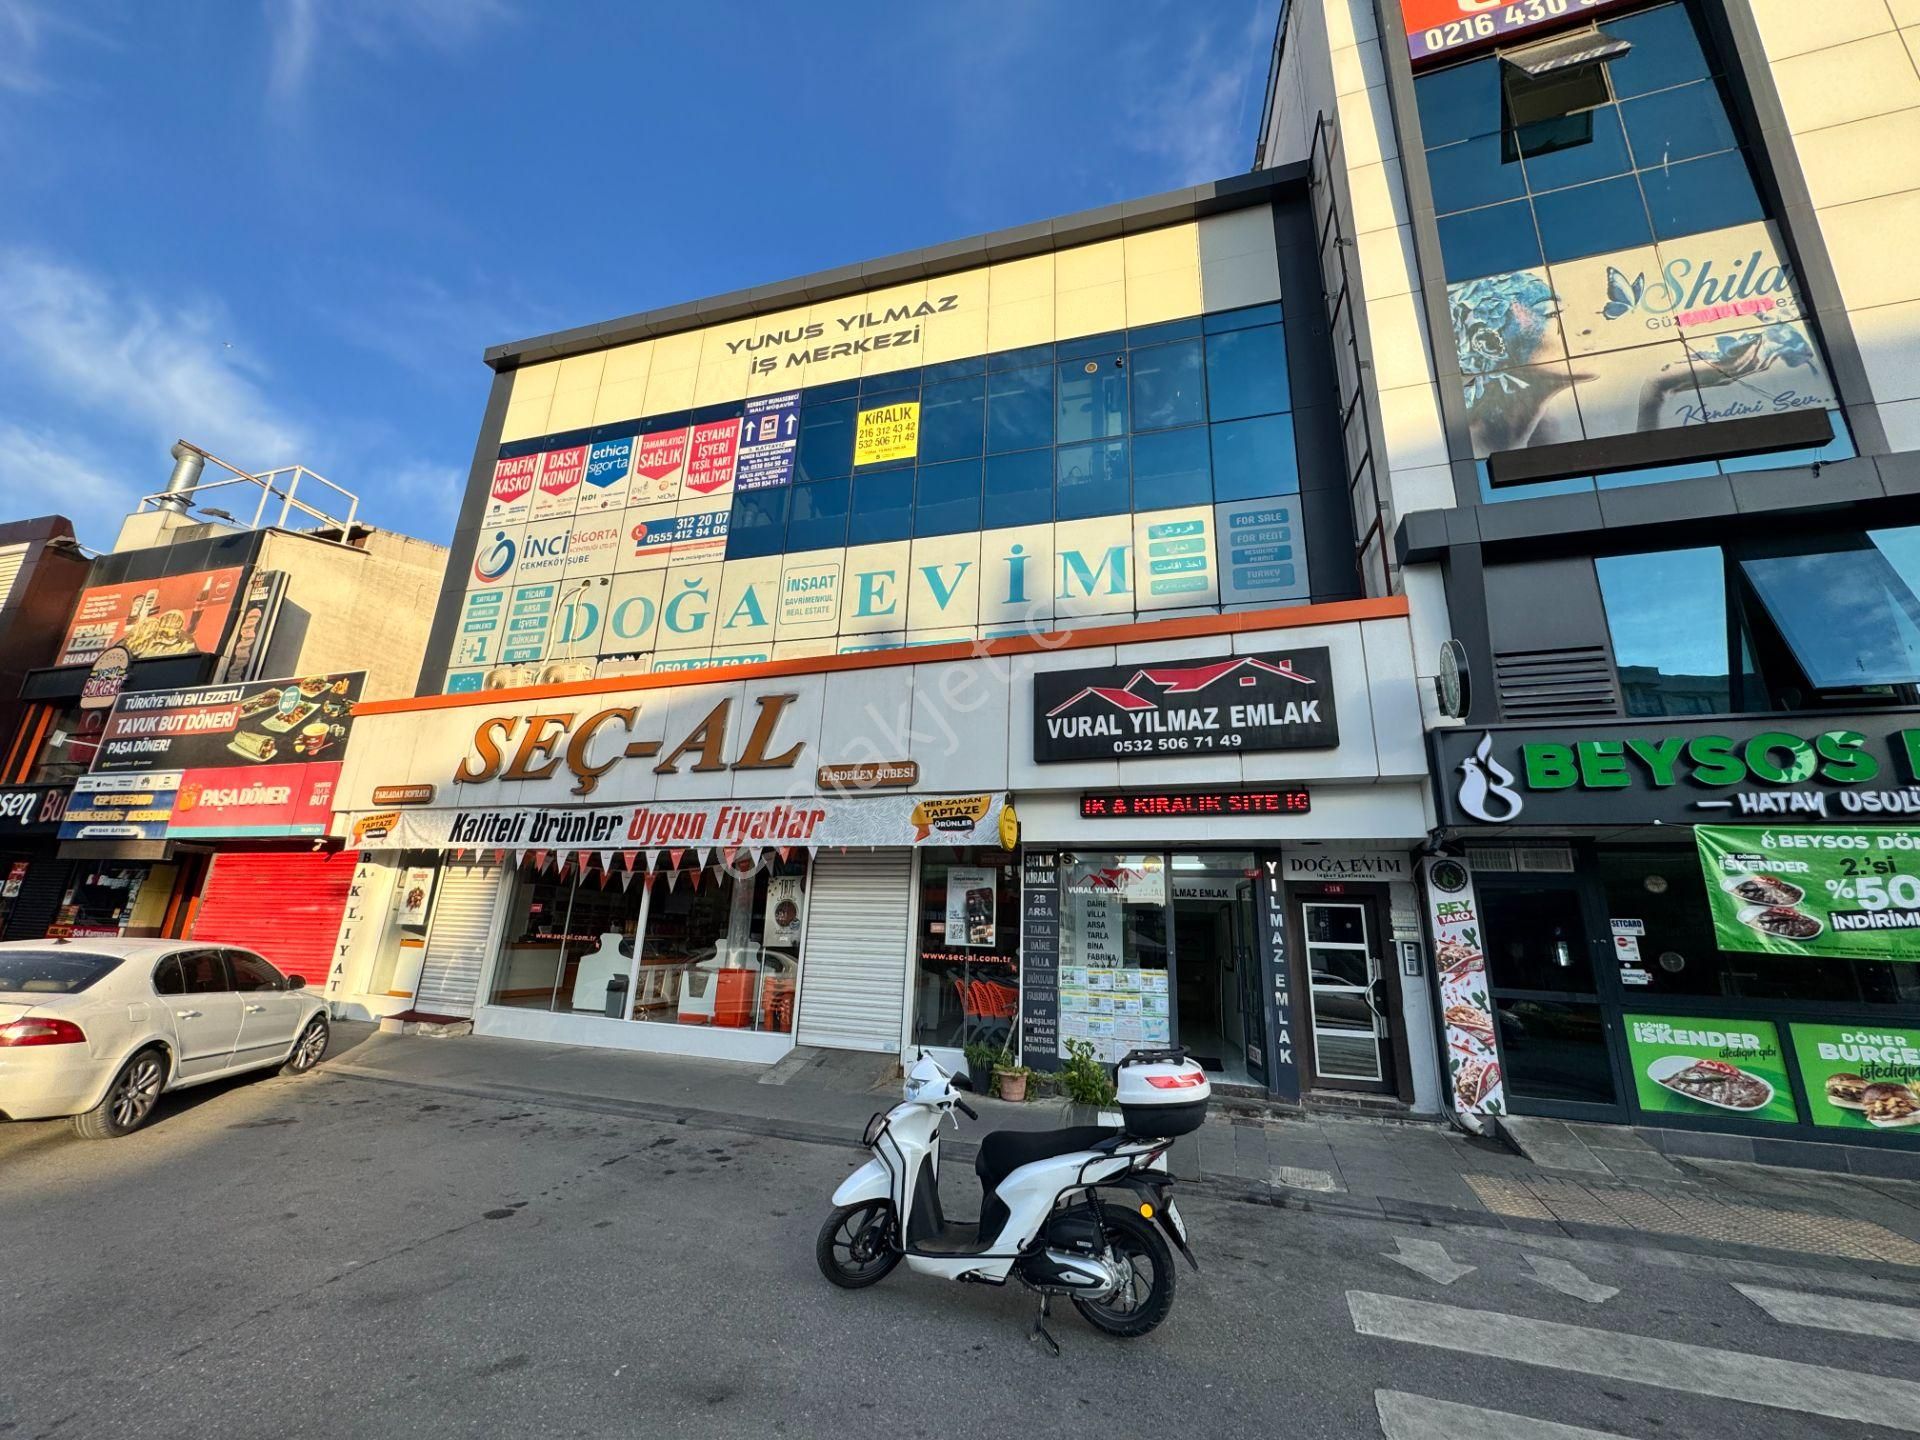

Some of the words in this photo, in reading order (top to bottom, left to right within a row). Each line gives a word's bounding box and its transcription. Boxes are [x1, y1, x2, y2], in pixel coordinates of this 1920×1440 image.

[1425, 13, 1494, 51] 0216
[1641, 250, 1790, 313] Shila
[726, 322, 824, 355] YUNUS
[837, 294, 959, 331] YILMAZ
[751, 355, 777, 376] İŞ
[785, 324, 920, 369] MERKEZİ
[1675, 400, 1763, 425] Kendini
[695, 425, 737, 443] SEYAHAT
[860, 428, 873, 438] 216
[876, 426, 890, 437] 312
[893, 424, 903, 433] 43
[906, 422, 916, 431] 42
[642, 435, 686, 449] TAMAMLAYICI
[859, 439, 873, 449] 532
[875, 436, 890, 446] 506
[893, 435, 902, 444] 71
[905, 432, 915, 441] 49
[592, 443, 629, 461] ethica
[640, 448, 682, 468] SAĞLIK
[698, 440, 729, 459] İŞYERİ
[498, 456, 536, 477] TRAFİK
[549, 451, 580, 470] DASK
[589, 457, 628, 475] sigorta
[692, 459, 711, 472] YEŞİL
[713, 456, 732, 467] KART
[494, 475, 531, 494] KASKO
[542, 467, 581, 487] KONUT
[686, 468, 733, 487] NAKLİYAT
[676, 516, 695, 530] 312
[698, 515, 712, 526] 20
[715, 512, 729, 524] 07
[1236, 515, 1255, 525] FOR
[1258, 512, 1282, 523] SALE
[647, 532, 672, 543] 0555
[675, 529, 692, 540] 412
[696, 527, 710, 537] 94
[713, 525, 728, 534] 06
[1237, 534, 1255, 544] FOR
[1259, 531, 1284, 542] RENT
[523, 530, 571, 558] İNCİ
[570, 529, 618, 544] SİGORTA
[786, 574, 836, 592] İNŞAAT
[786, 608, 803, 616] REAL
[805, 605, 830, 615] ESTATE
[72, 621, 119, 638] EFSANE
[66, 635, 113, 652] LEZZET
[181, 693, 199, 706] EN
[199, 686, 245, 705] LEZZETLİ
[116, 716, 160, 735] TAVUK
[158, 713, 187, 731] BUT
[185, 707, 238, 729] DÖNERİ
[1046, 715, 1122, 739] VURAL
[1129, 707, 1220, 734] YILMAZ
[1230, 700, 1321, 728] EMLAK
[107, 740, 132, 755] PAŞA
[134, 738, 171, 752] DÖNER!
[452, 693, 807, 796] SEÇ-AL
[1113, 738, 1152, 752] 0532
[1158, 737, 1188, 750] 506
[1193, 736, 1213, 749] 71
[1220, 734, 1242, 747] 49
[1523, 731, 1880, 789] BEYSOS
[821, 769, 873, 782] TAŞDELEN
[877, 764, 914, 780] ŞUBESİ
[199, 788, 238, 811] PAŞA
[238, 782, 291, 805] DÖNER
[309, 795, 330, 806] BUT
[924, 800, 943, 808] HER
[945, 797, 982, 806] ZAMAN
[1738, 791, 1827, 818] HATAY
[0, 793, 37, 825] sen
[924, 805, 980, 819] TAPTAZE
[362, 820, 393, 829] TAPTAZE
[448, 812, 527, 843] Kaliteli
[529, 807, 623, 843] Ürünler
[712, 806, 825, 847] Fiyatlar
[934, 818, 973, 828] ÜRÜNLER
[1778, 834, 1870, 850] BEYSOS
[1026, 854, 1054, 867] SATILIK
[1290, 855, 1346, 873] DOĞA
[1350, 856, 1402, 873] EVİM
[1719, 855, 1810, 873] İSKENDER
[1026, 870, 1055, 884] KİRALIK
[1068, 886, 1092, 894] VURAL
[1199, 888, 1229, 898] EMLAK
[1825, 874, 1920, 911] %50
[1033, 894, 1047, 904] 2B
[1087, 899, 1107, 908] DAİRE
[1436, 900, 1470, 915] BEY
[1027, 907, 1054, 917] ARSA
[1087, 909, 1106, 918] VİLLA
[1265, 861, 1284, 963] YILMAZ
[1439, 912, 1470, 923] TAKO
[1030, 925, 1051, 935] TARLA
[1087, 921, 1106, 929] ARSA
[1611, 920, 1642, 928] SETCARD
[1087, 932, 1109, 940] TARLA
[1087, 942, 1104, 950] BİNA
[921, 952, 1012, 963] www.sec-al.com.tr
[1030, 955, 1050, 967] VİLLA
[1087, 952, 1116, 961] FABRİKA
[1274, 973, 1293, 1065] EMLAK
[1025, 1037, 1055, 1045] KENTSEL
[1842, 1031, 1907, 1046] DÖNER
[1818, 1043, 1920, 1066] BURGE
